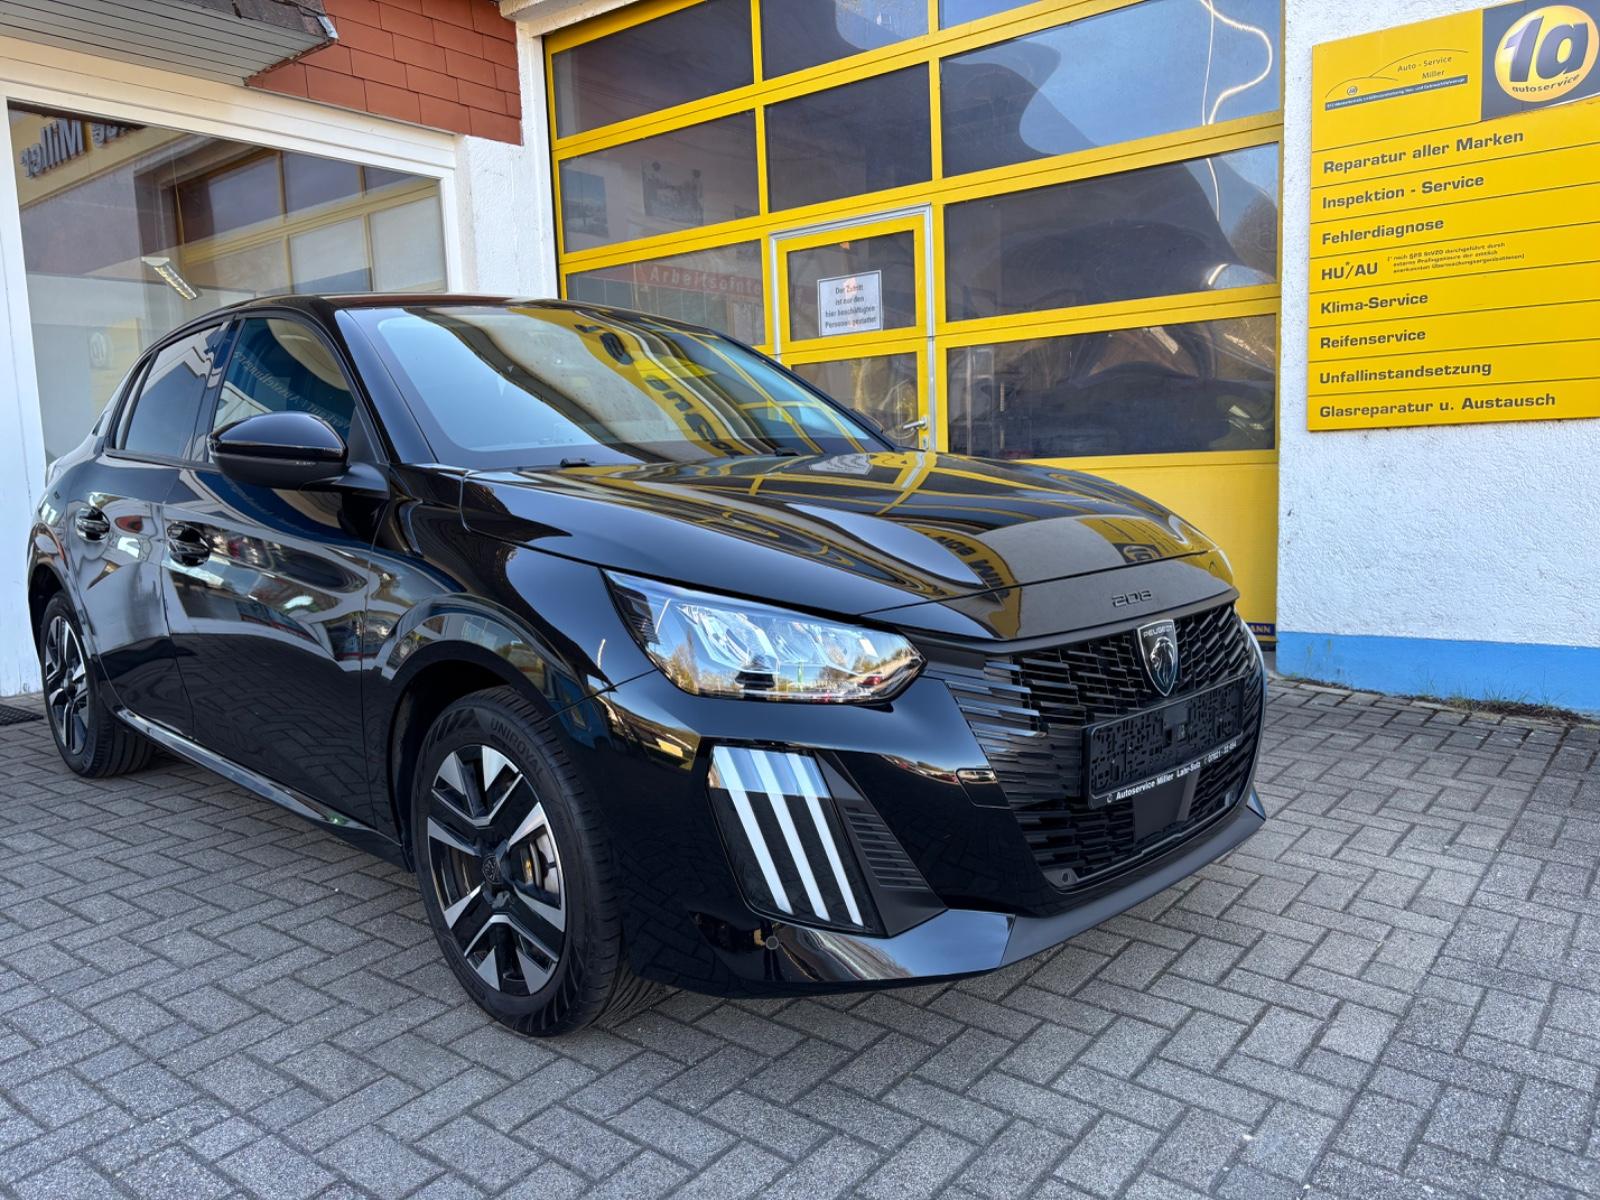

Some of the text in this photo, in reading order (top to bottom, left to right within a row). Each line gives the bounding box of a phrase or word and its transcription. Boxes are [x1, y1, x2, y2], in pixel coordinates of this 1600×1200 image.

[1504, 16, 1588, 83] 1a
[1397, 62, 1417, 73] Auto
[1423, 56, 1453, 67] Service
[1421, 69, 1445, 80] Miller
[1511, 73, 1580, 94] autoservice
[1323, 131, 1524, 174] Reparatur aller Marken
[1322, 187, 1405, 209] Inspektion
[1421, 175, 1484, 195] Service
[1322, 219, 1444, 245] Fehlerdiagnose
[1321, 293, 1429, 315] Klima-Service
[1320, 329, 1426, 350] Reifenservice
[1320, 363, 1492, 385] Unfallinstandsetzung
[1319, 393, 1556, 418] Glasreparatur u. Austausch
[1111, 589, 1152, 608] 208
[1143, 624, 1173, 639] PEUGEOT
[490, 717, 545, 783] UNIROYAL
[1116, 780, 1156, 801] Autoservice
[1156, 772, 1175, 786] Miller
